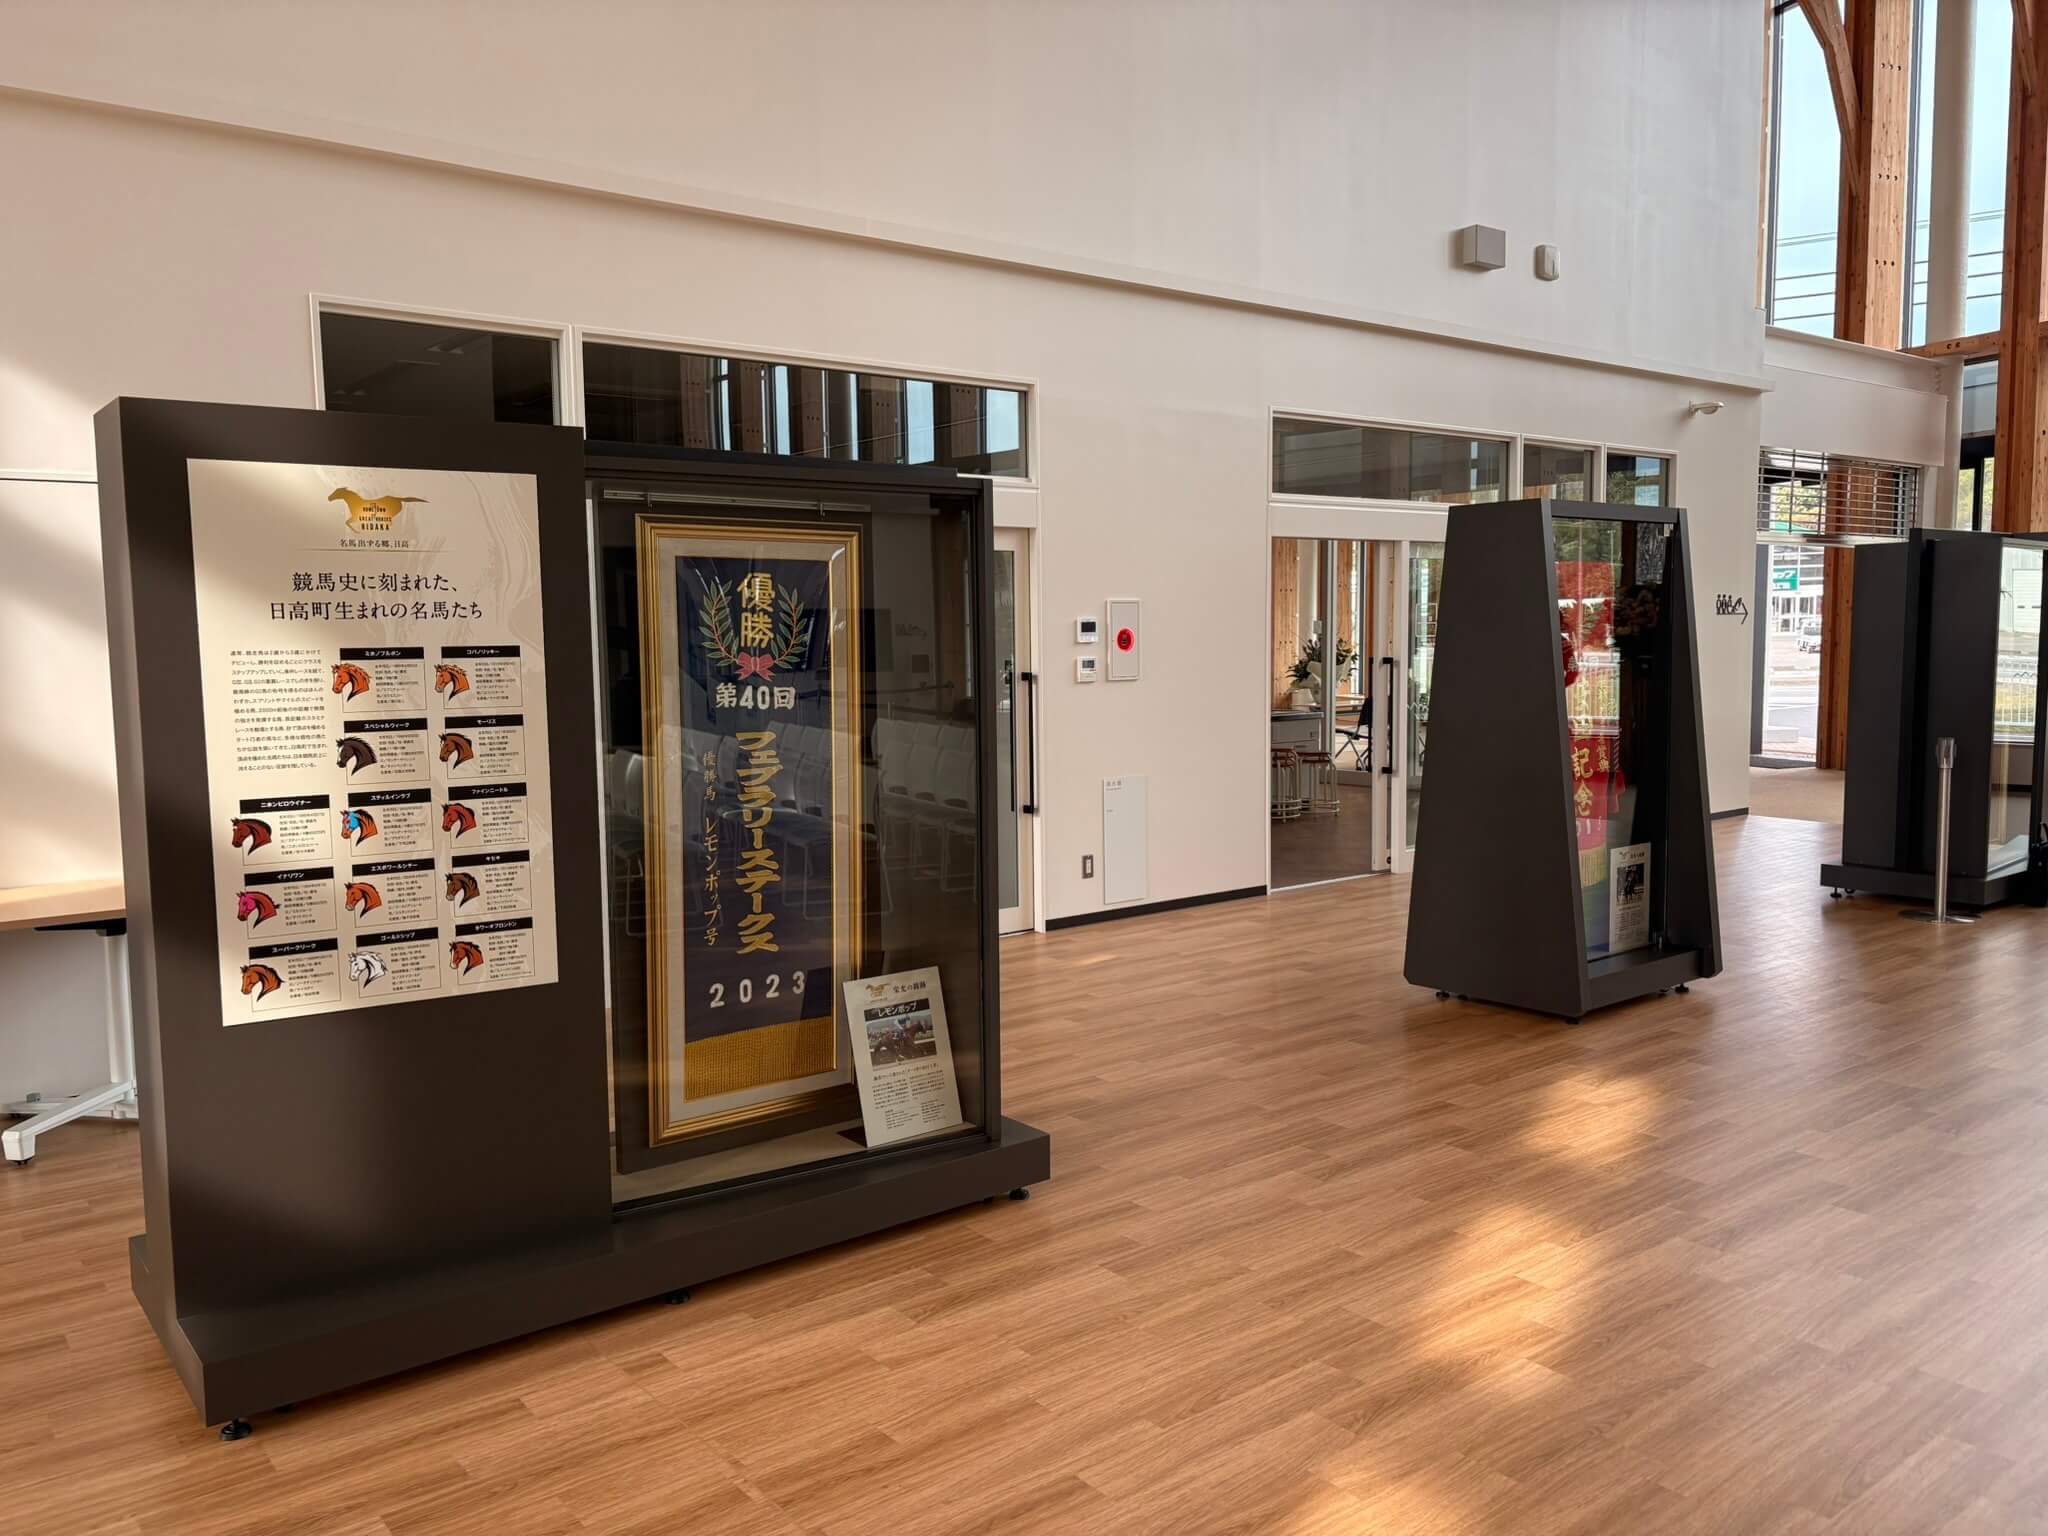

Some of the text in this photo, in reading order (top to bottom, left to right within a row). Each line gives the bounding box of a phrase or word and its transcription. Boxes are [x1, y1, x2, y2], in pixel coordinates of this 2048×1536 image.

[291, 571, 459, 594] 競馬史に刻まれた、
[270, 600, 483, 622] 日高町生まれの名馬たち
[736, 571, 776, 648] 優勝
[715, 682, 796, 711] 第40回
[363, 722, 411, 730] スペシャルウィーク
[260, 799, 312, 808] ニホンピロウイナー
[370, 792, 411, 801] スティルインラブ
[736, 731, 783, 956] フェブラリーステークス
[371, 862, 418, 872] エスポワールシチー
[277, 872, 305, 880] イナリワン
[703, 816, 721, 947] レモンポップ号
[380, 931, 417, 942] ゴールドシップ
[271, 943, 317, 953] スーパークリーク
[709, 970, 805, 1009] 2023
[877, 1001, 918, 1017] レモンポップ
